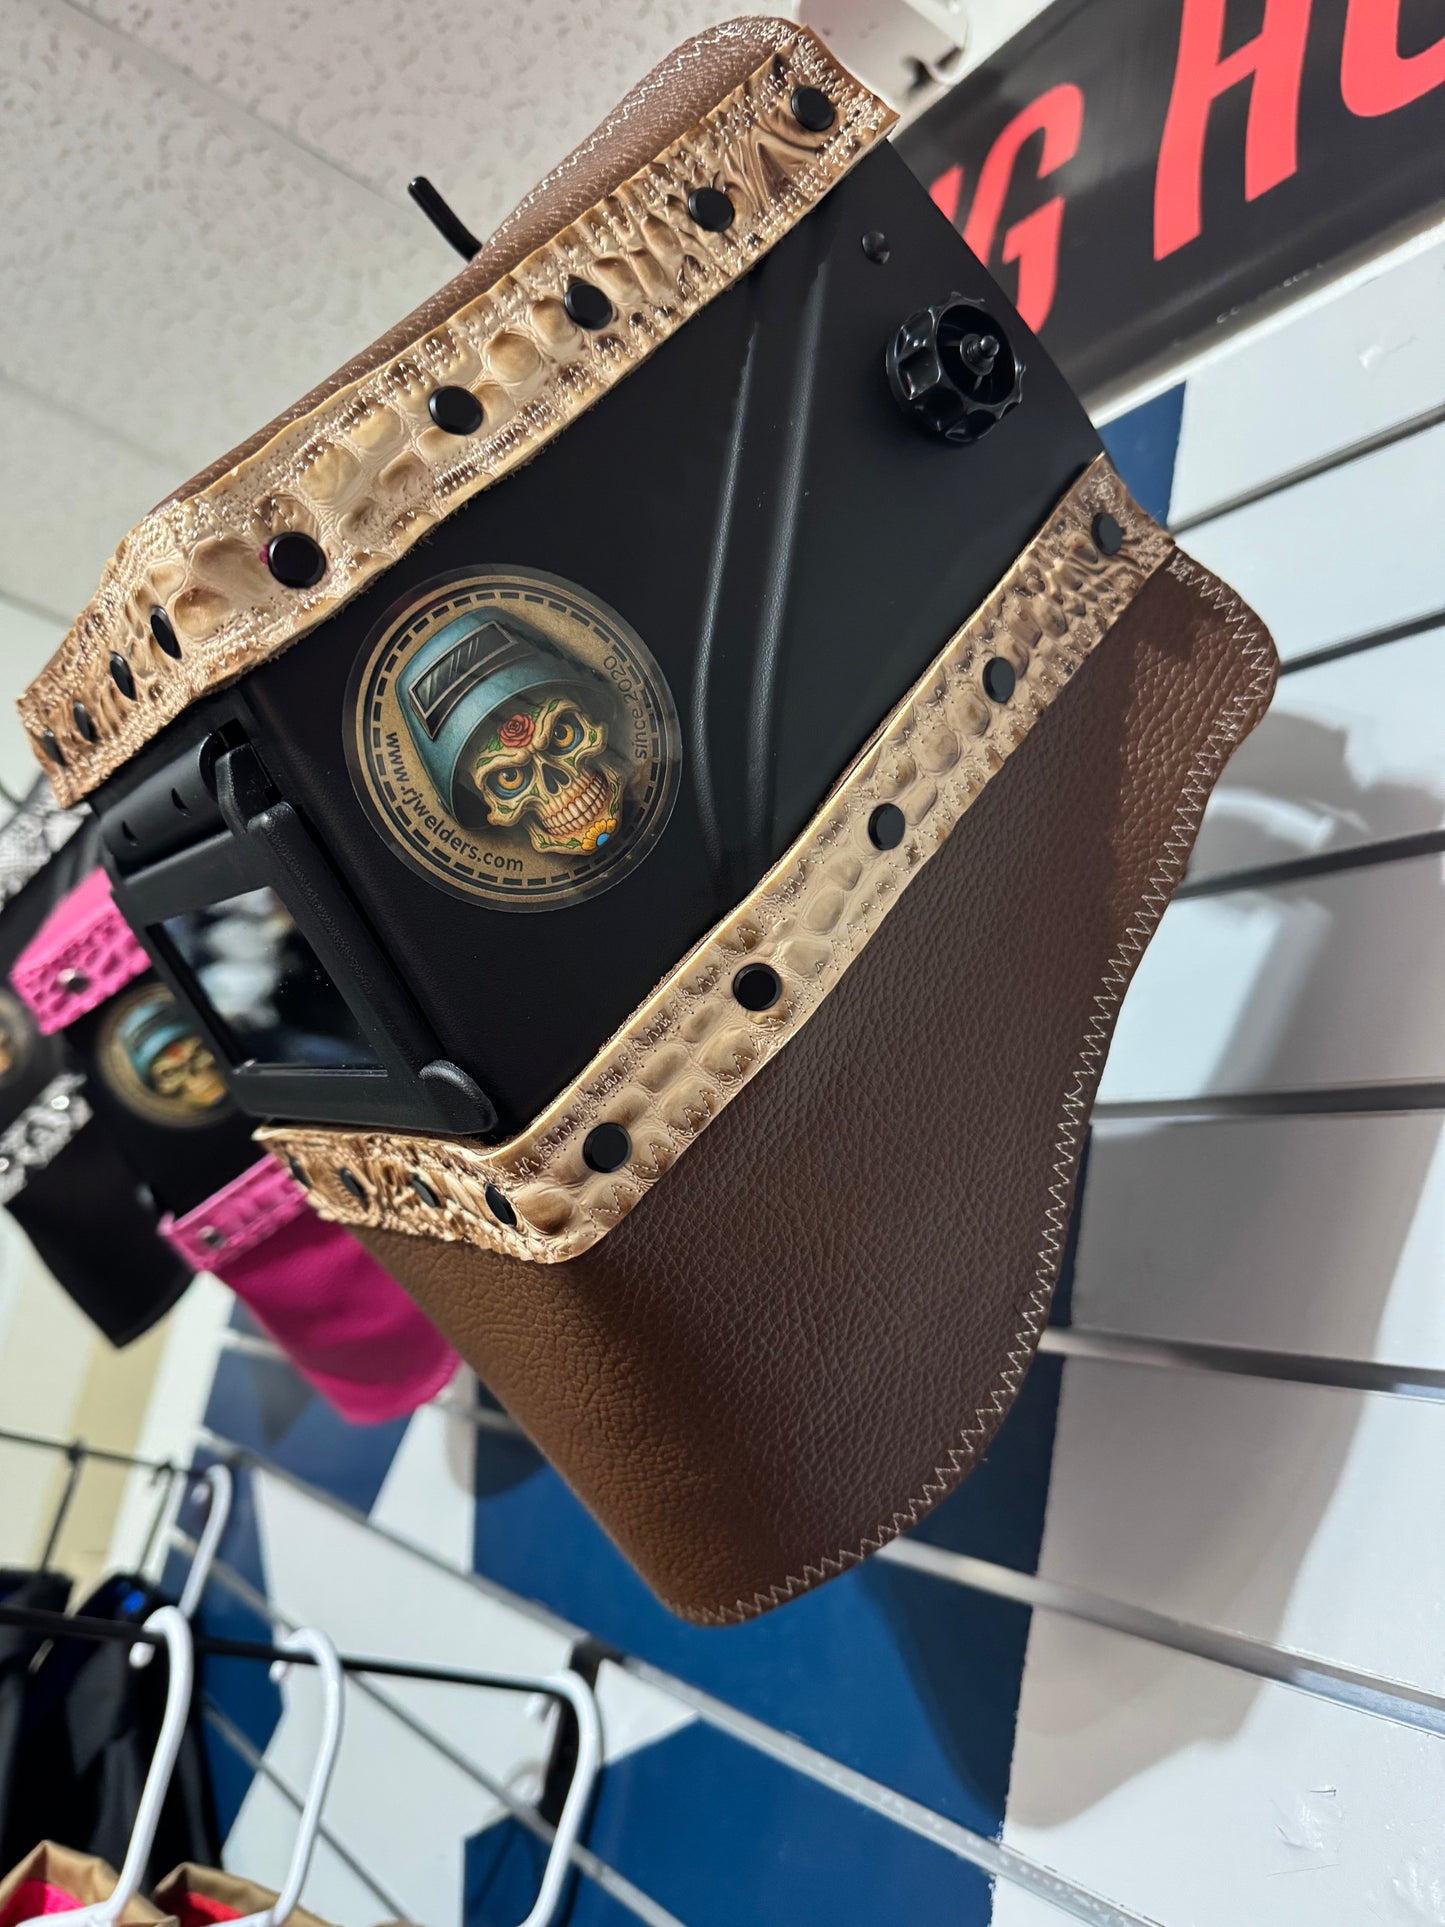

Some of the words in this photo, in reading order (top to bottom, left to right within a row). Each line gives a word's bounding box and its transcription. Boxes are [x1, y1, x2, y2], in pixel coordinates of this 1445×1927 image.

[603, 655, 640, 705] 2020
[631, 707, 649, 760] since
[385, 731, 524, 873] www.rjwelders.com
